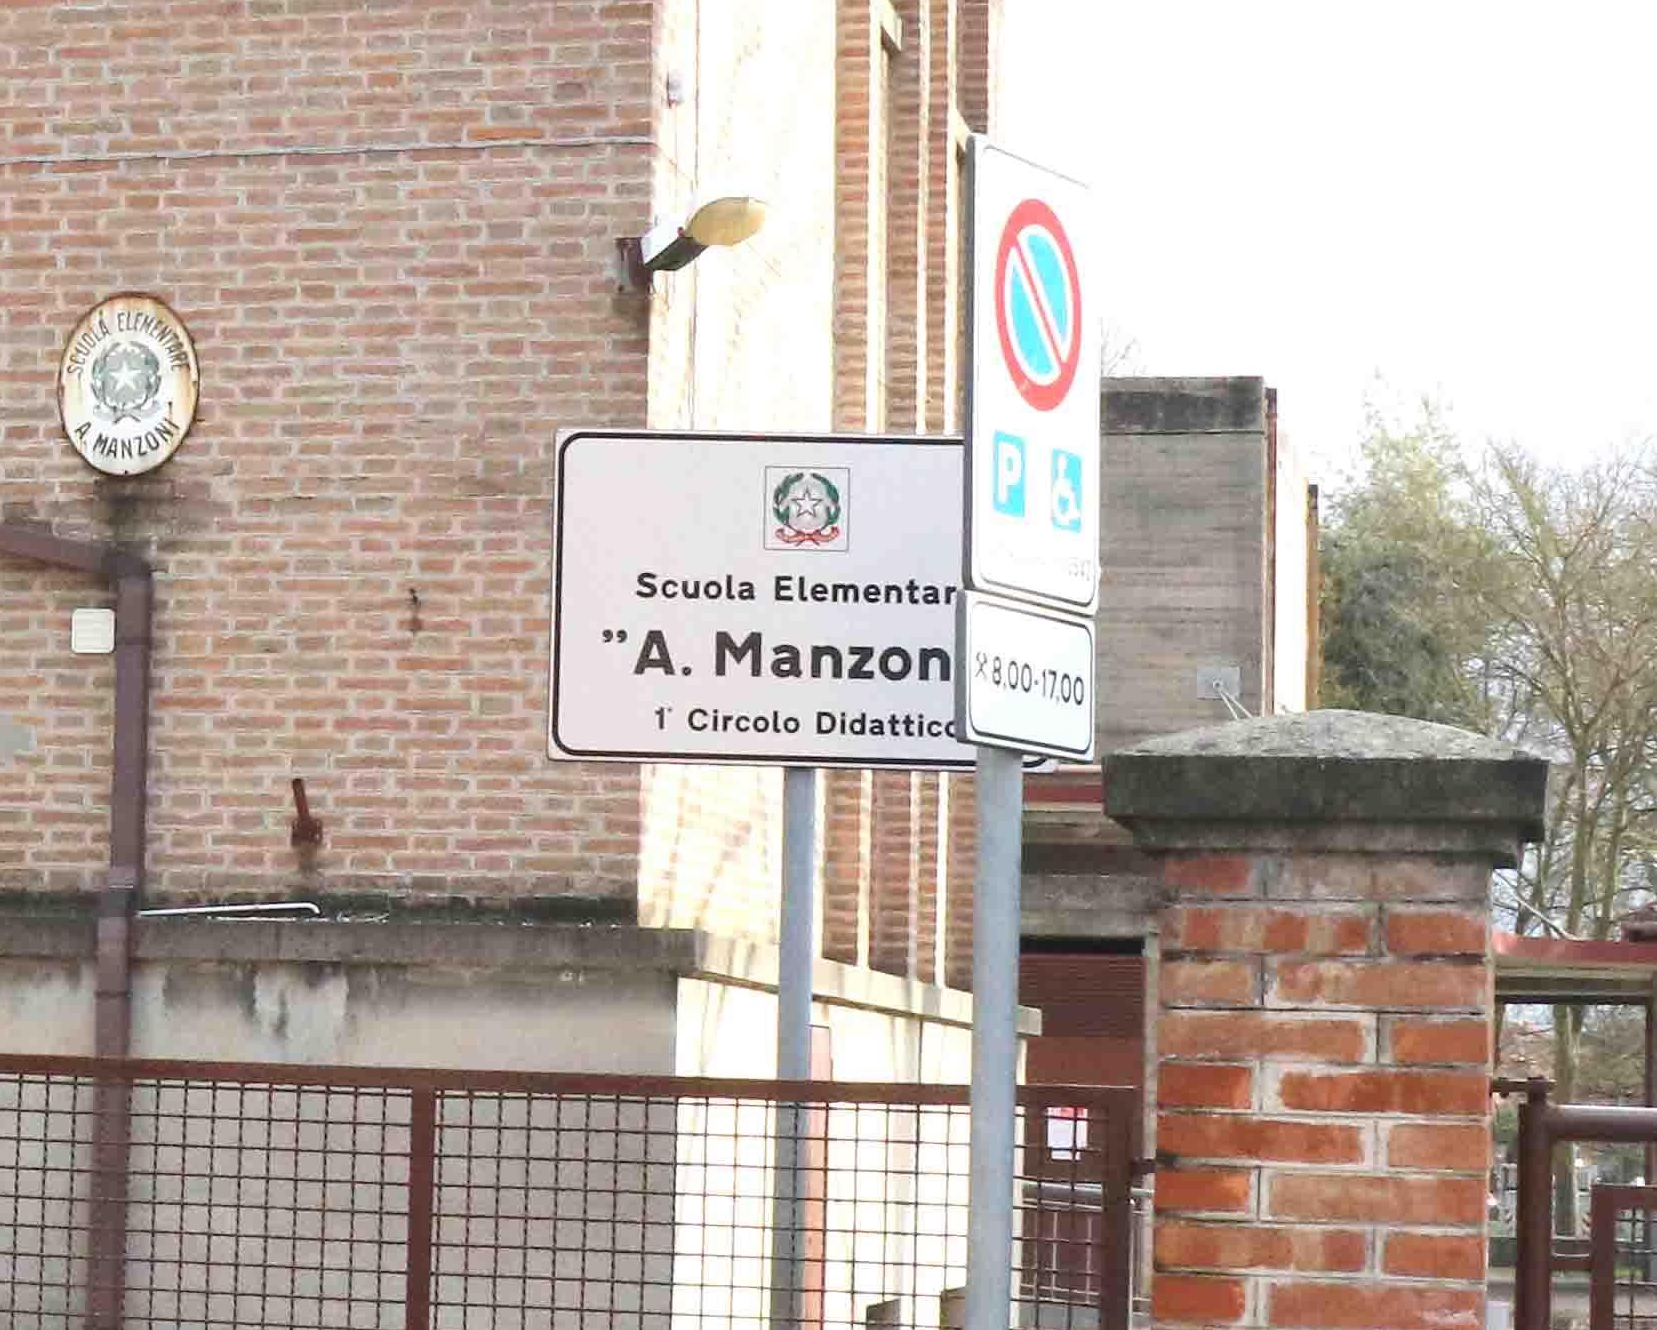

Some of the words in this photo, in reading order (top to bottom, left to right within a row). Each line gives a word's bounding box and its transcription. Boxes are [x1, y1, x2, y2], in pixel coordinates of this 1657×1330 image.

[67, 317, 110, 374] SCUOLA
[92, 417, 181, 459] MANZONI
[636, 572, 756, 601] Scuola
[774, 575, 957, 605] Elementar
[714, 631, 952, 681] Manzon
[687, 708, 800, 735] Circolo
